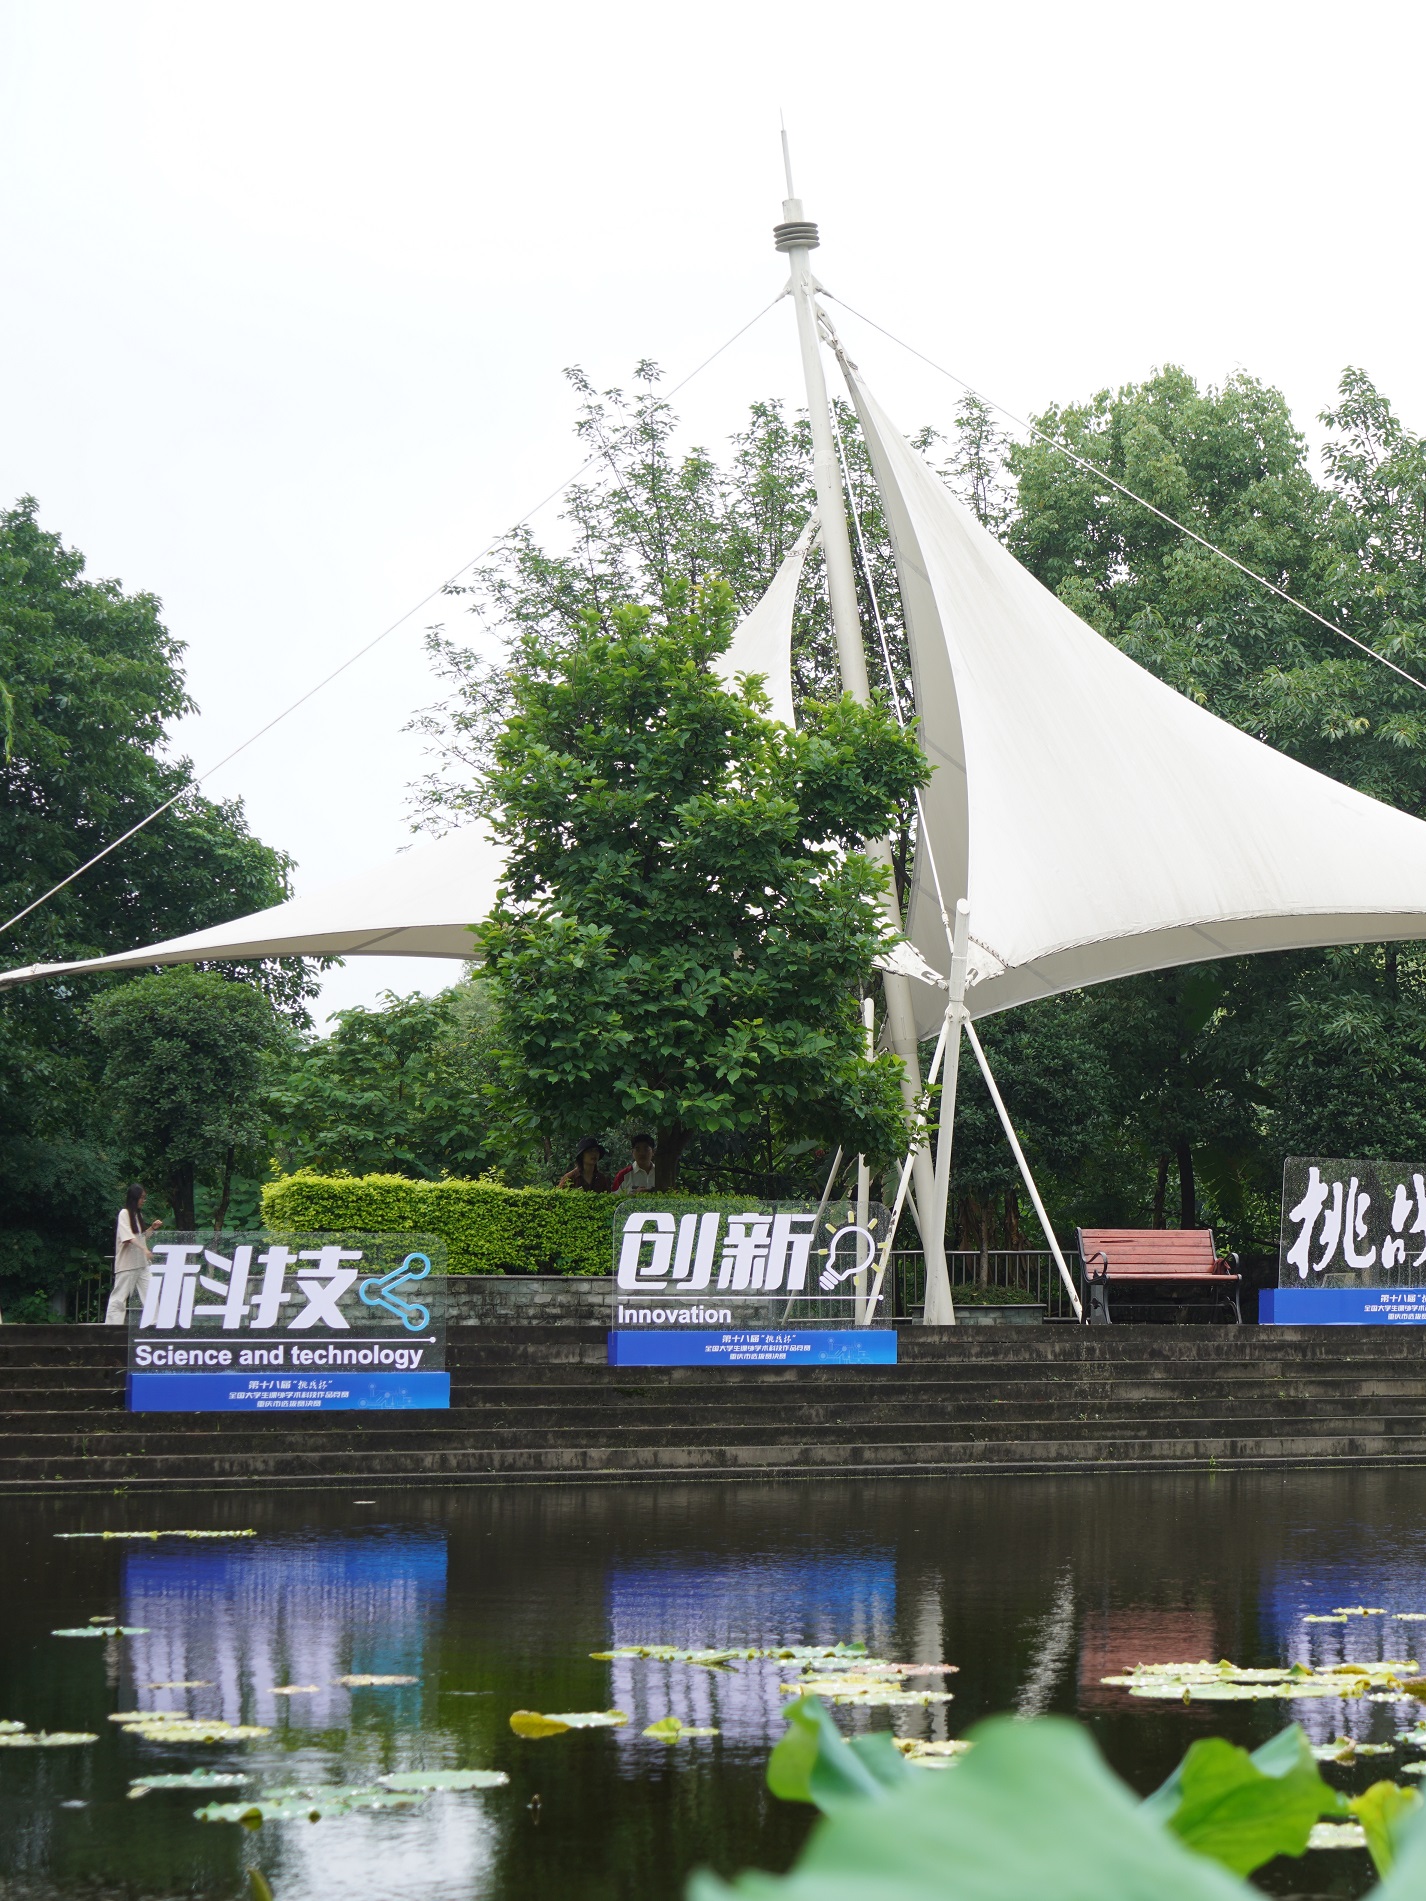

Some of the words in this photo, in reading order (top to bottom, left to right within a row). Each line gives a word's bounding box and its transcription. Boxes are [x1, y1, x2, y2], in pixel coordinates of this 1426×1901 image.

[617, 1212, 818, 1290] 创新
[139, 1244, 363, 1329] 科技
[618, 1305, 732, 1324] Innovation
[135, 1345, 232, 1366] Science
[239, 1345, 284, 1366] and
[292, 1345, 424, 1369] technology
